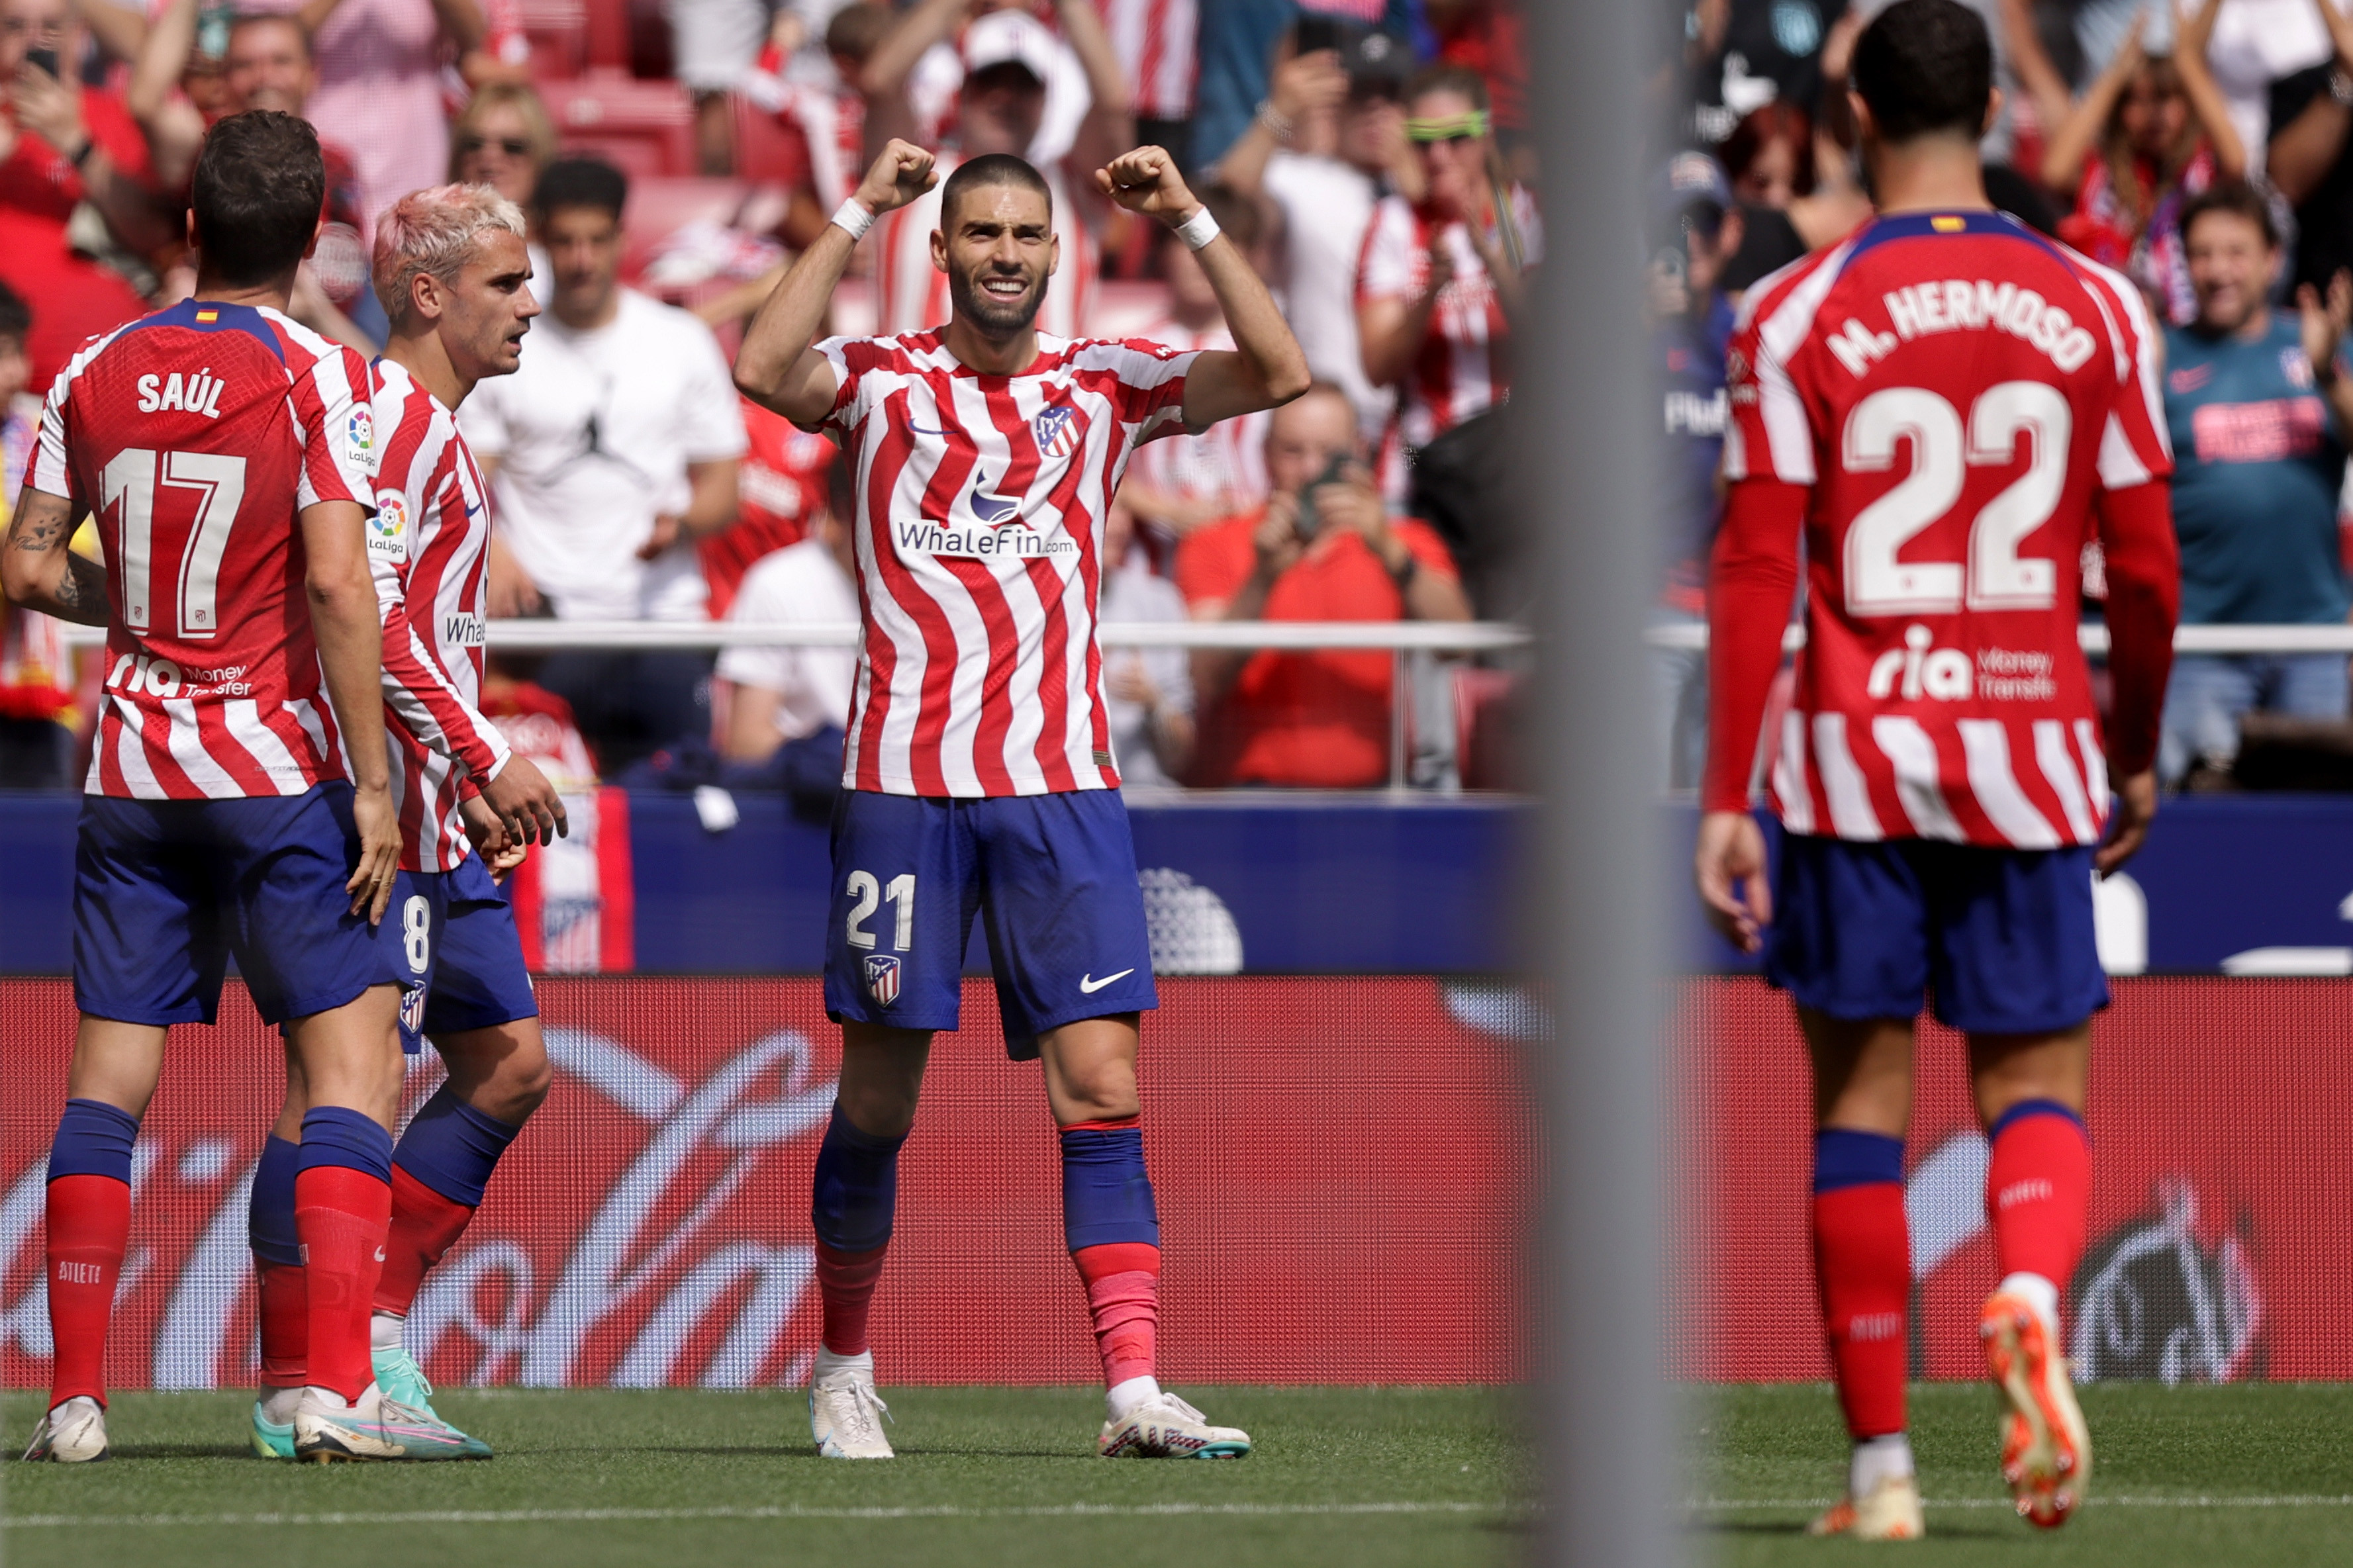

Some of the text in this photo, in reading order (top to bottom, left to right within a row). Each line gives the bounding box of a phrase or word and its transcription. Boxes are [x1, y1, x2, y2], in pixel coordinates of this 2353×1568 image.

[1825, 279, 2097, 379] M. HERMOSO
[137, 367, 225, 419] SAÚL
[349, 451, 375, 467] LaLiga
[1841, 380, 2073, 618] 22
[99, 447, 247, 639] 17
[369, 539, 404, 554] LaLiga
[898, 522, 1073, 555] WhaleFin.com
[106, 645, 181, 698] ria
[185, 665, 247, 683] Money
[1866, 623, 1974, 701] ria
[404, 895, 430, 974] 8
[847, 870, 916, 952] 21
